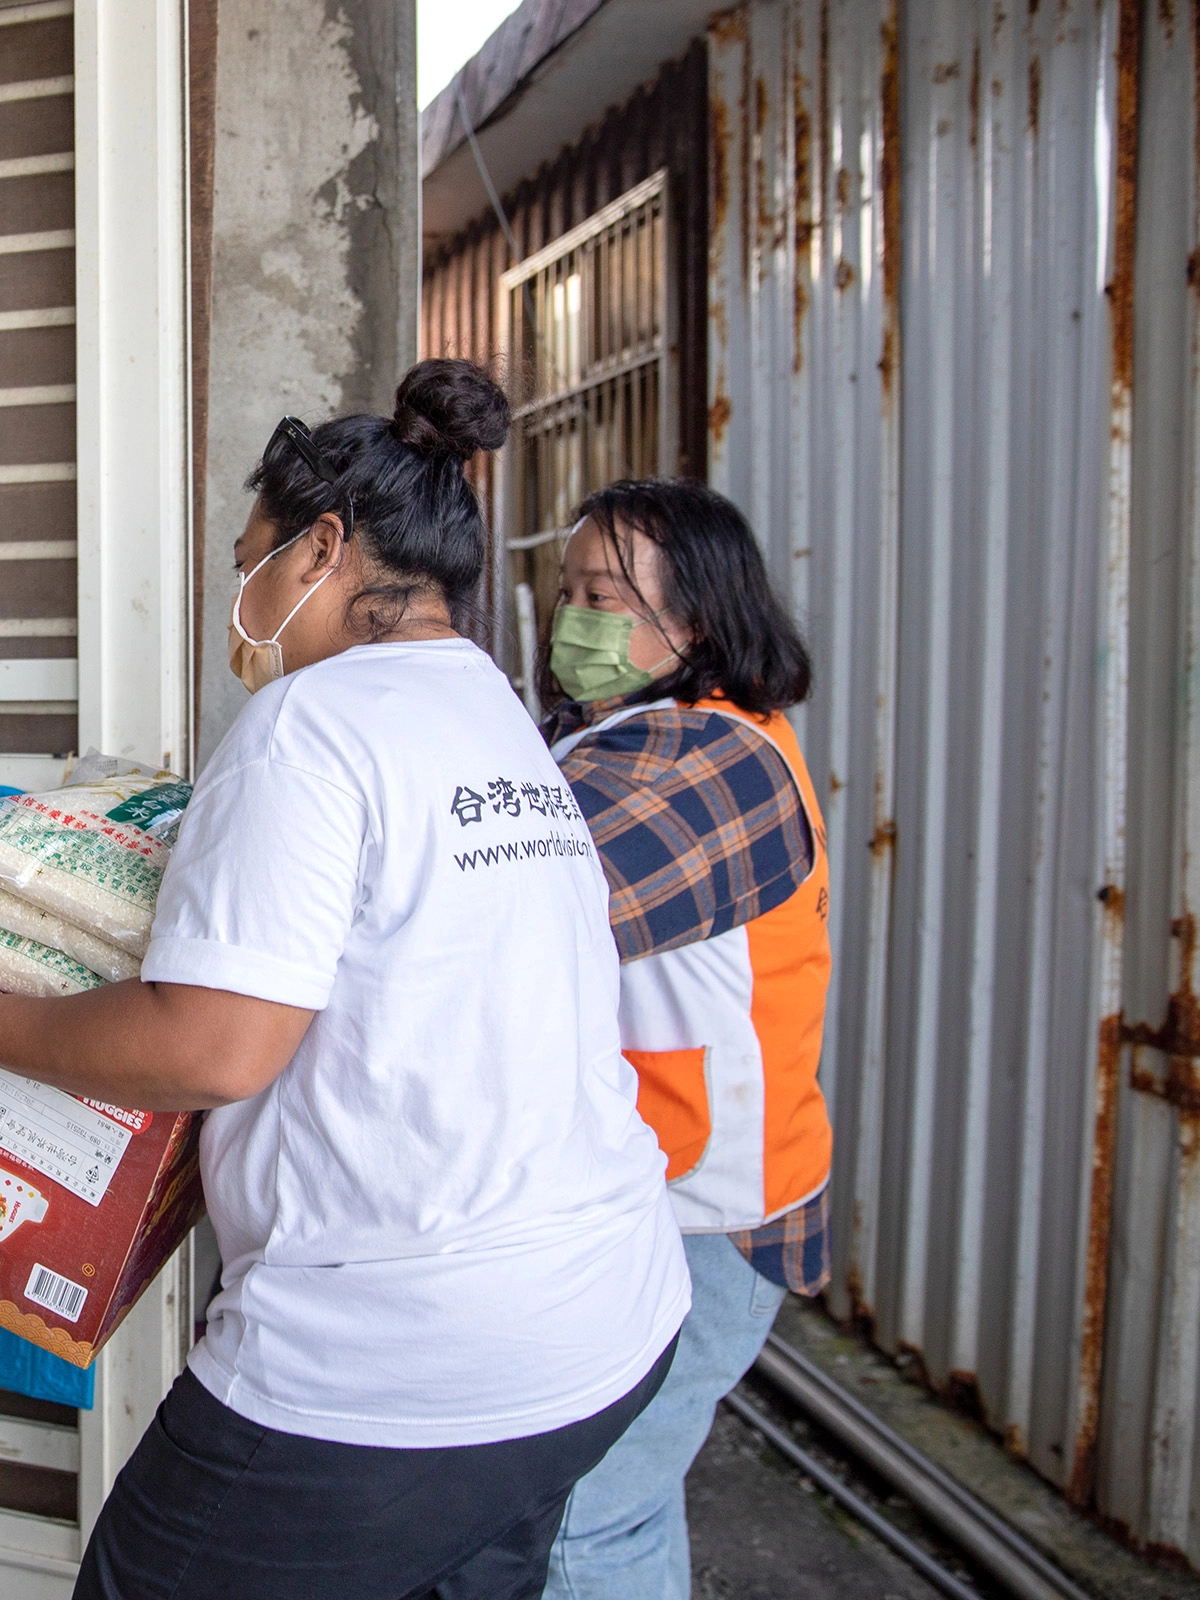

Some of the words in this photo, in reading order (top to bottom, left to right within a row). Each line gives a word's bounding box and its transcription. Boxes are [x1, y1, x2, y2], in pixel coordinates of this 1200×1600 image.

[6, 1118, 78, 1167] 台灣世界展望會
